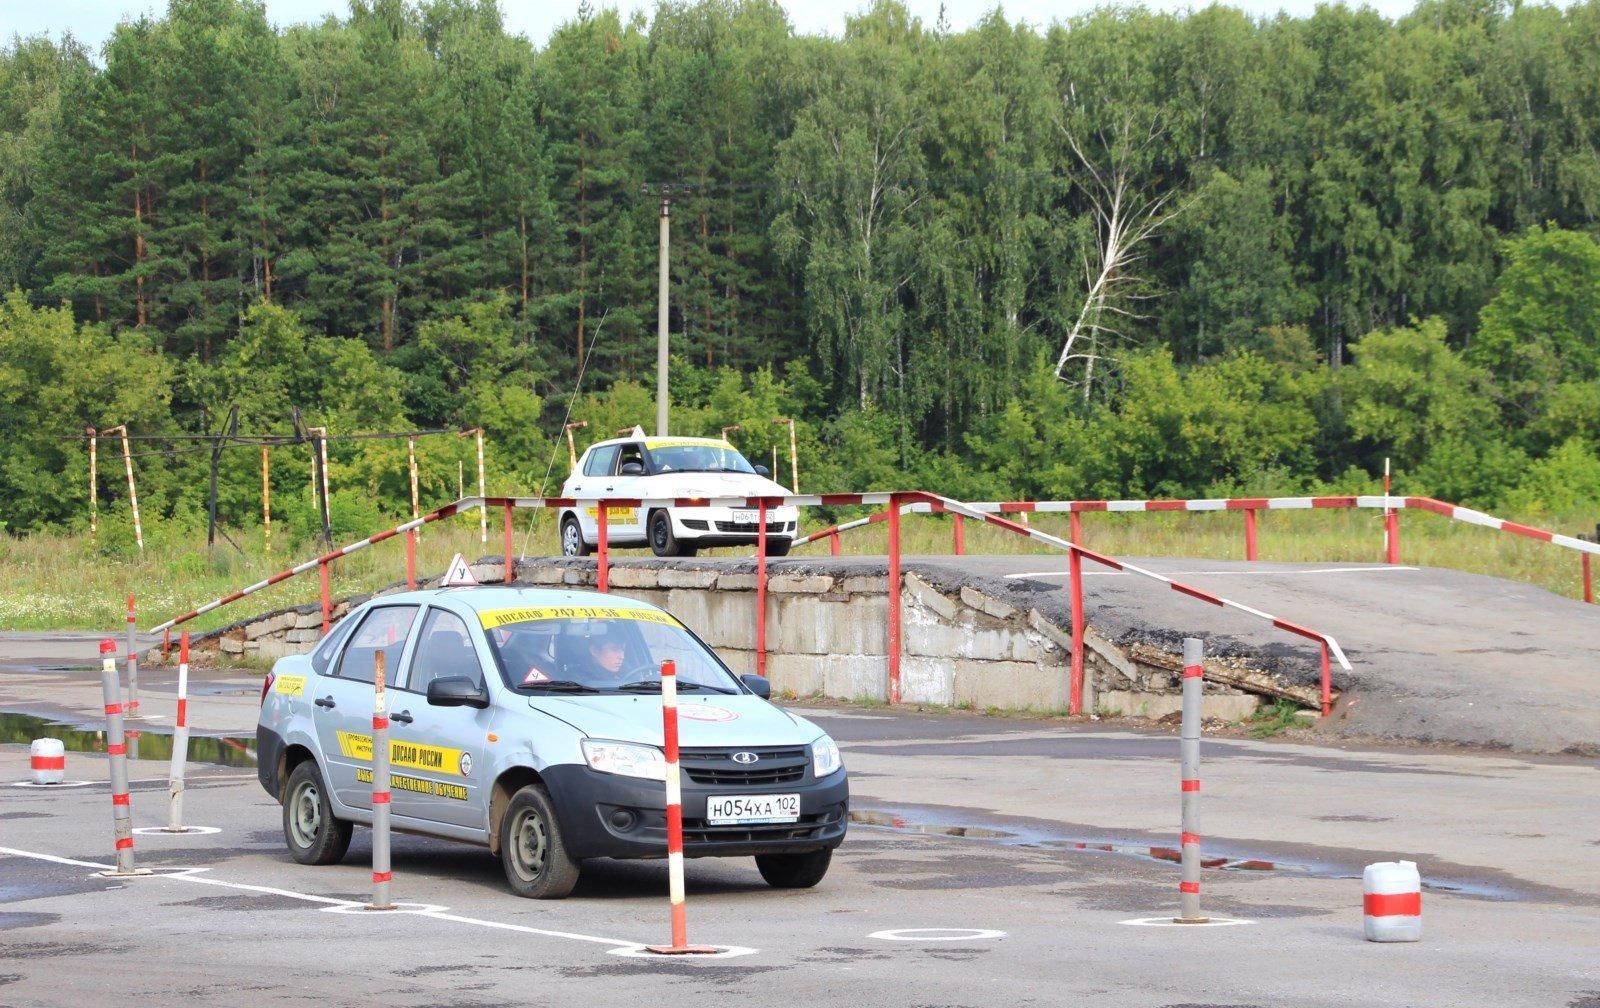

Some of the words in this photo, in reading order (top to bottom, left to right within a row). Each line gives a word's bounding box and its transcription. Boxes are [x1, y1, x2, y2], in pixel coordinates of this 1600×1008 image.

[495, 610, 543, 624] ДОСААФ
[392, 744, 417, 763] ДОСААФ
[419, 749, 443, 768] РОССИИ
[390, 775, 434, 796] АЧЕСТВЕННОЕ
[435, 782, 468, 801] ОБУЧЕНИЕ
[776, 797, 796, 810] 102
